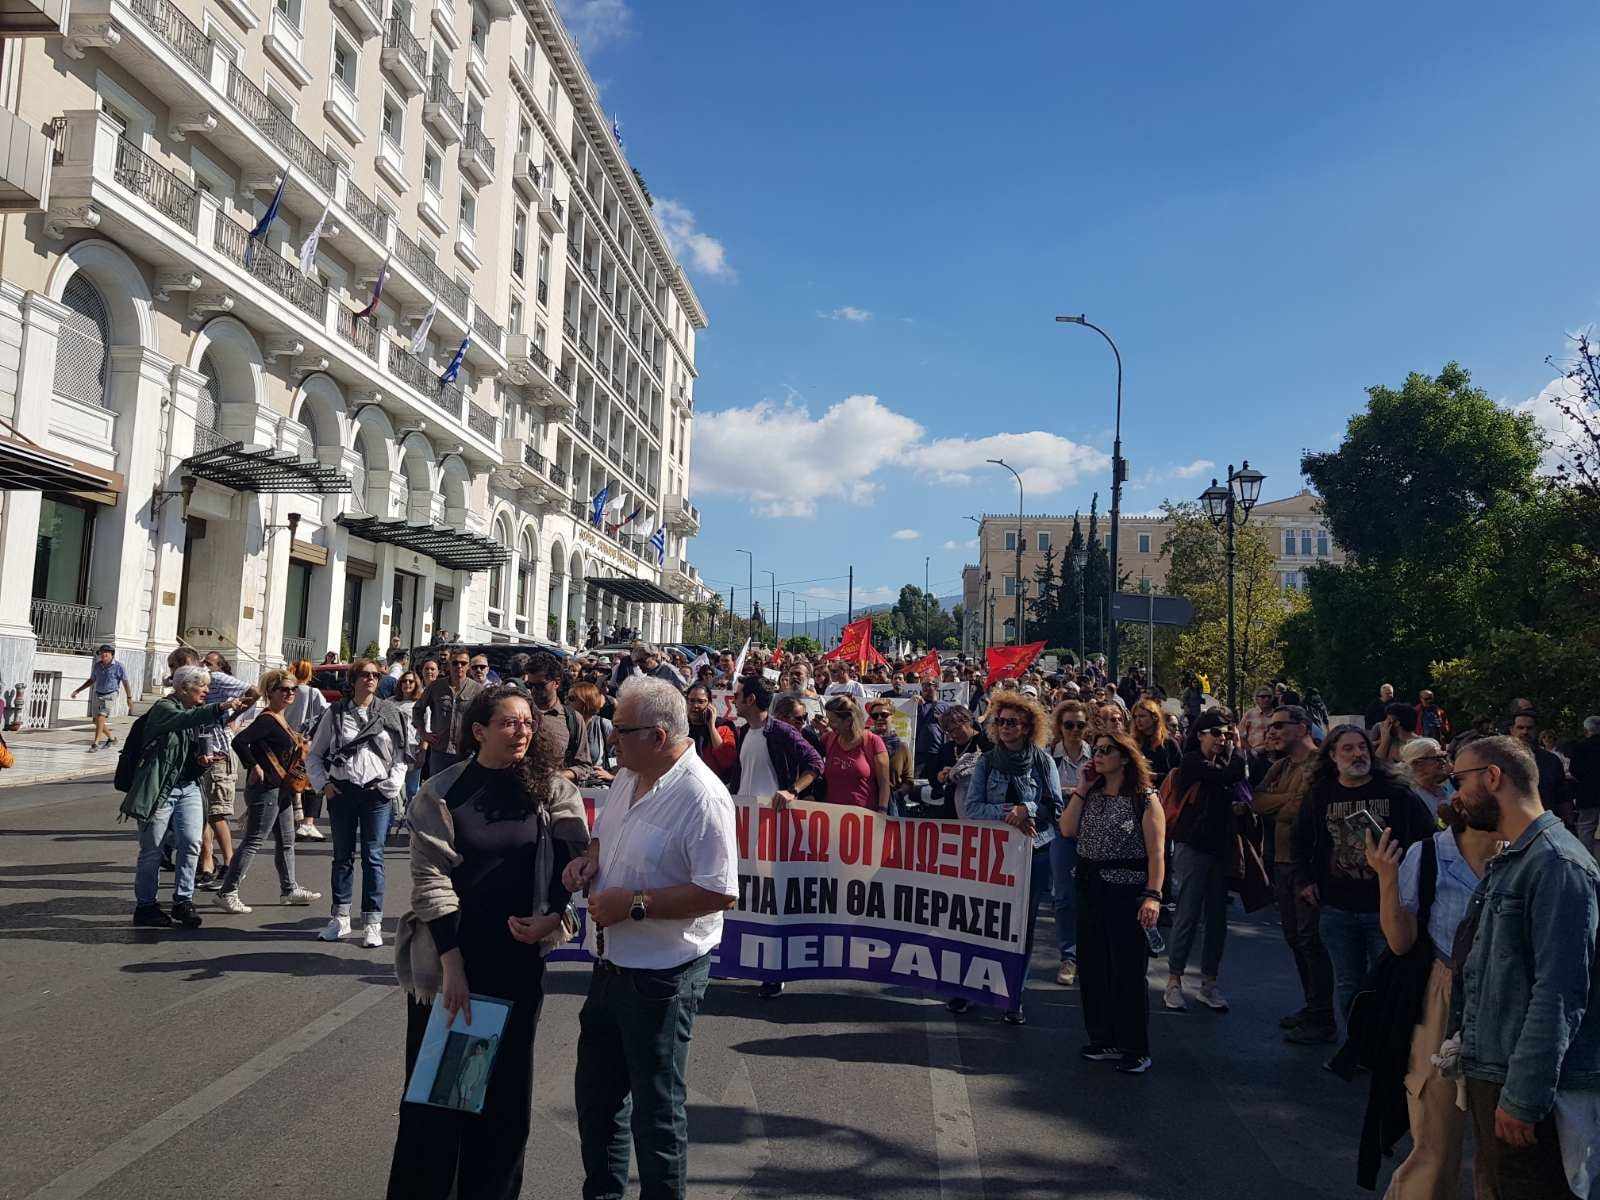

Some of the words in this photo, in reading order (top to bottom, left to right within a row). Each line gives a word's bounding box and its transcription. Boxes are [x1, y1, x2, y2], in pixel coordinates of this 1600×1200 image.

[758, 807, 830, 862] ΠΙΣΩ
[839, 812, 874, 866] ΟΙ
[880, 819, 1015, 887] ΔΙΩΞΕΙΣ.
[783, 876, 838, 915] ΔΕΝ
[846, 879, 886, 920] ΘΑ
[893, 883, 1018, 943] ΠΕΡΑΣΕΙ.
[739, 933, 1010, 998] ΠΕΙΡΑΙΑ
